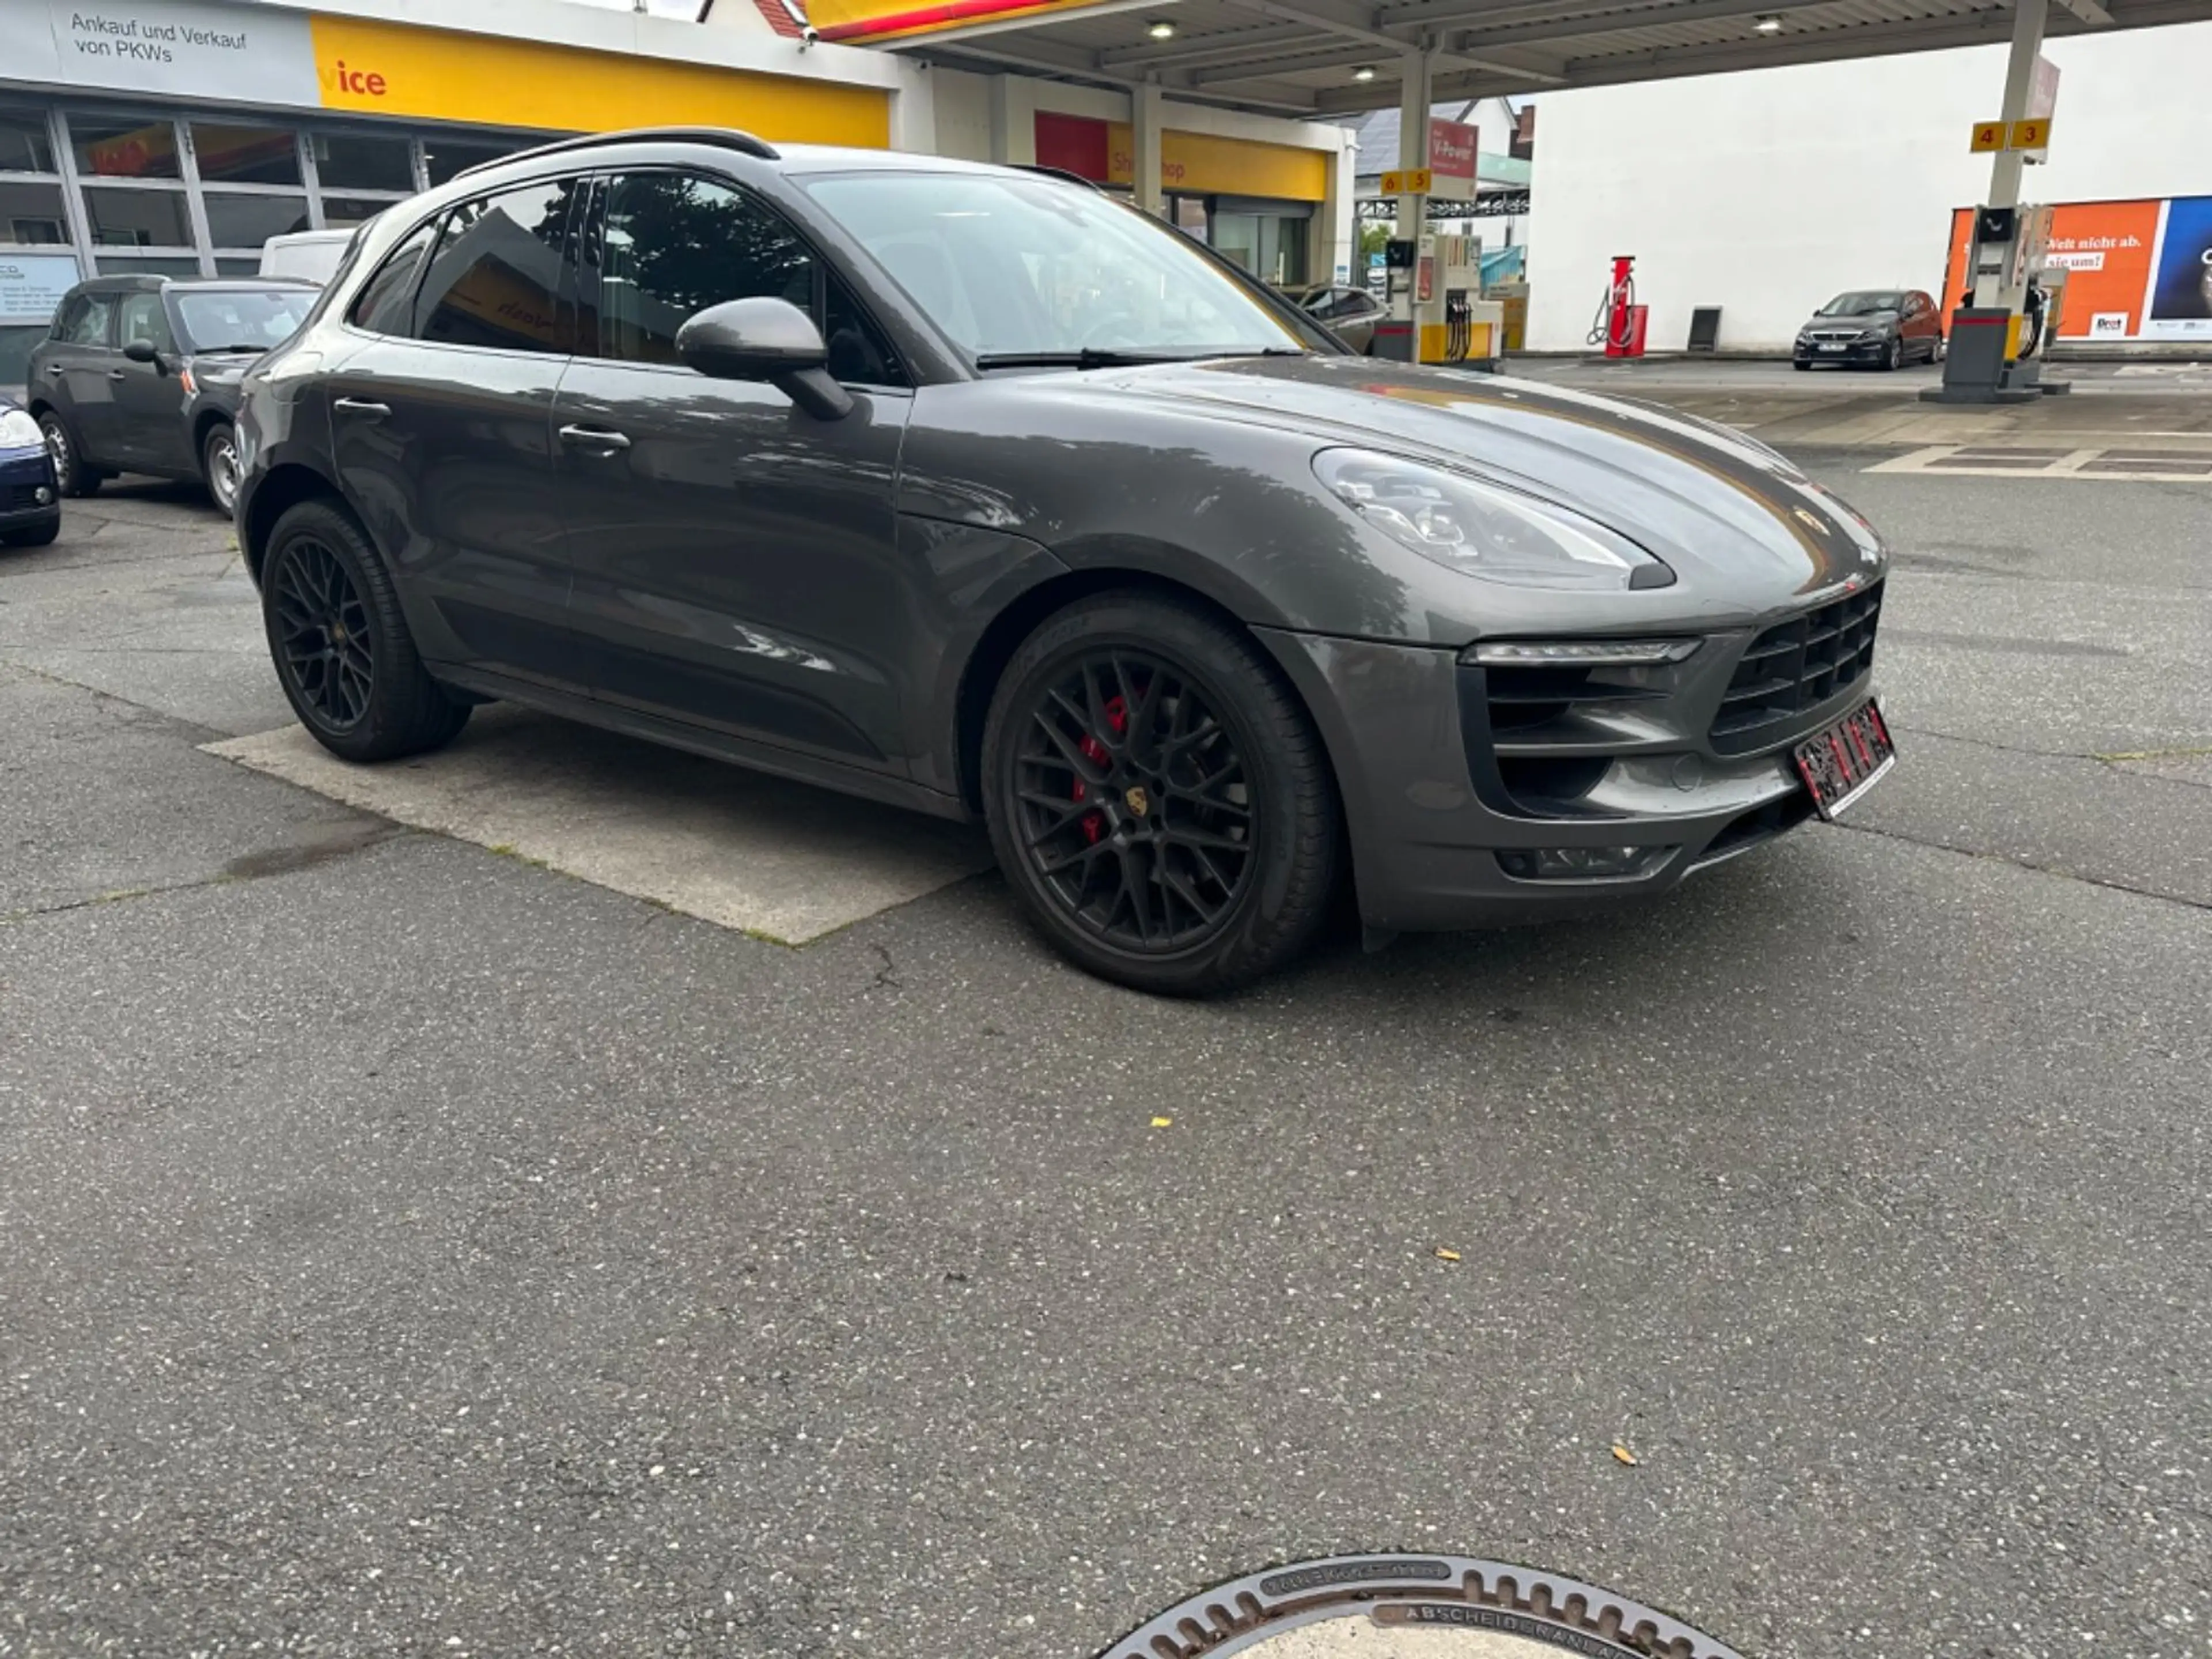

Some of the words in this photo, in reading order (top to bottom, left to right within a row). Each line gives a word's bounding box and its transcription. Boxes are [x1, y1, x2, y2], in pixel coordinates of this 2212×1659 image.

[71, 13, 137, 37] Ankauf
[142, 25, 176, 41] und
[180, 25, 247, 50] Verkauf
[74, 38, 111, 56] von
[116, 39, 173, 63] PKWs
[1980, 128, 1994, 143] 4
[2025, 126, 2036, 143] 3
[1385, 177, 1395, 190] 6
[1416, 173, 1426, 187] 5
